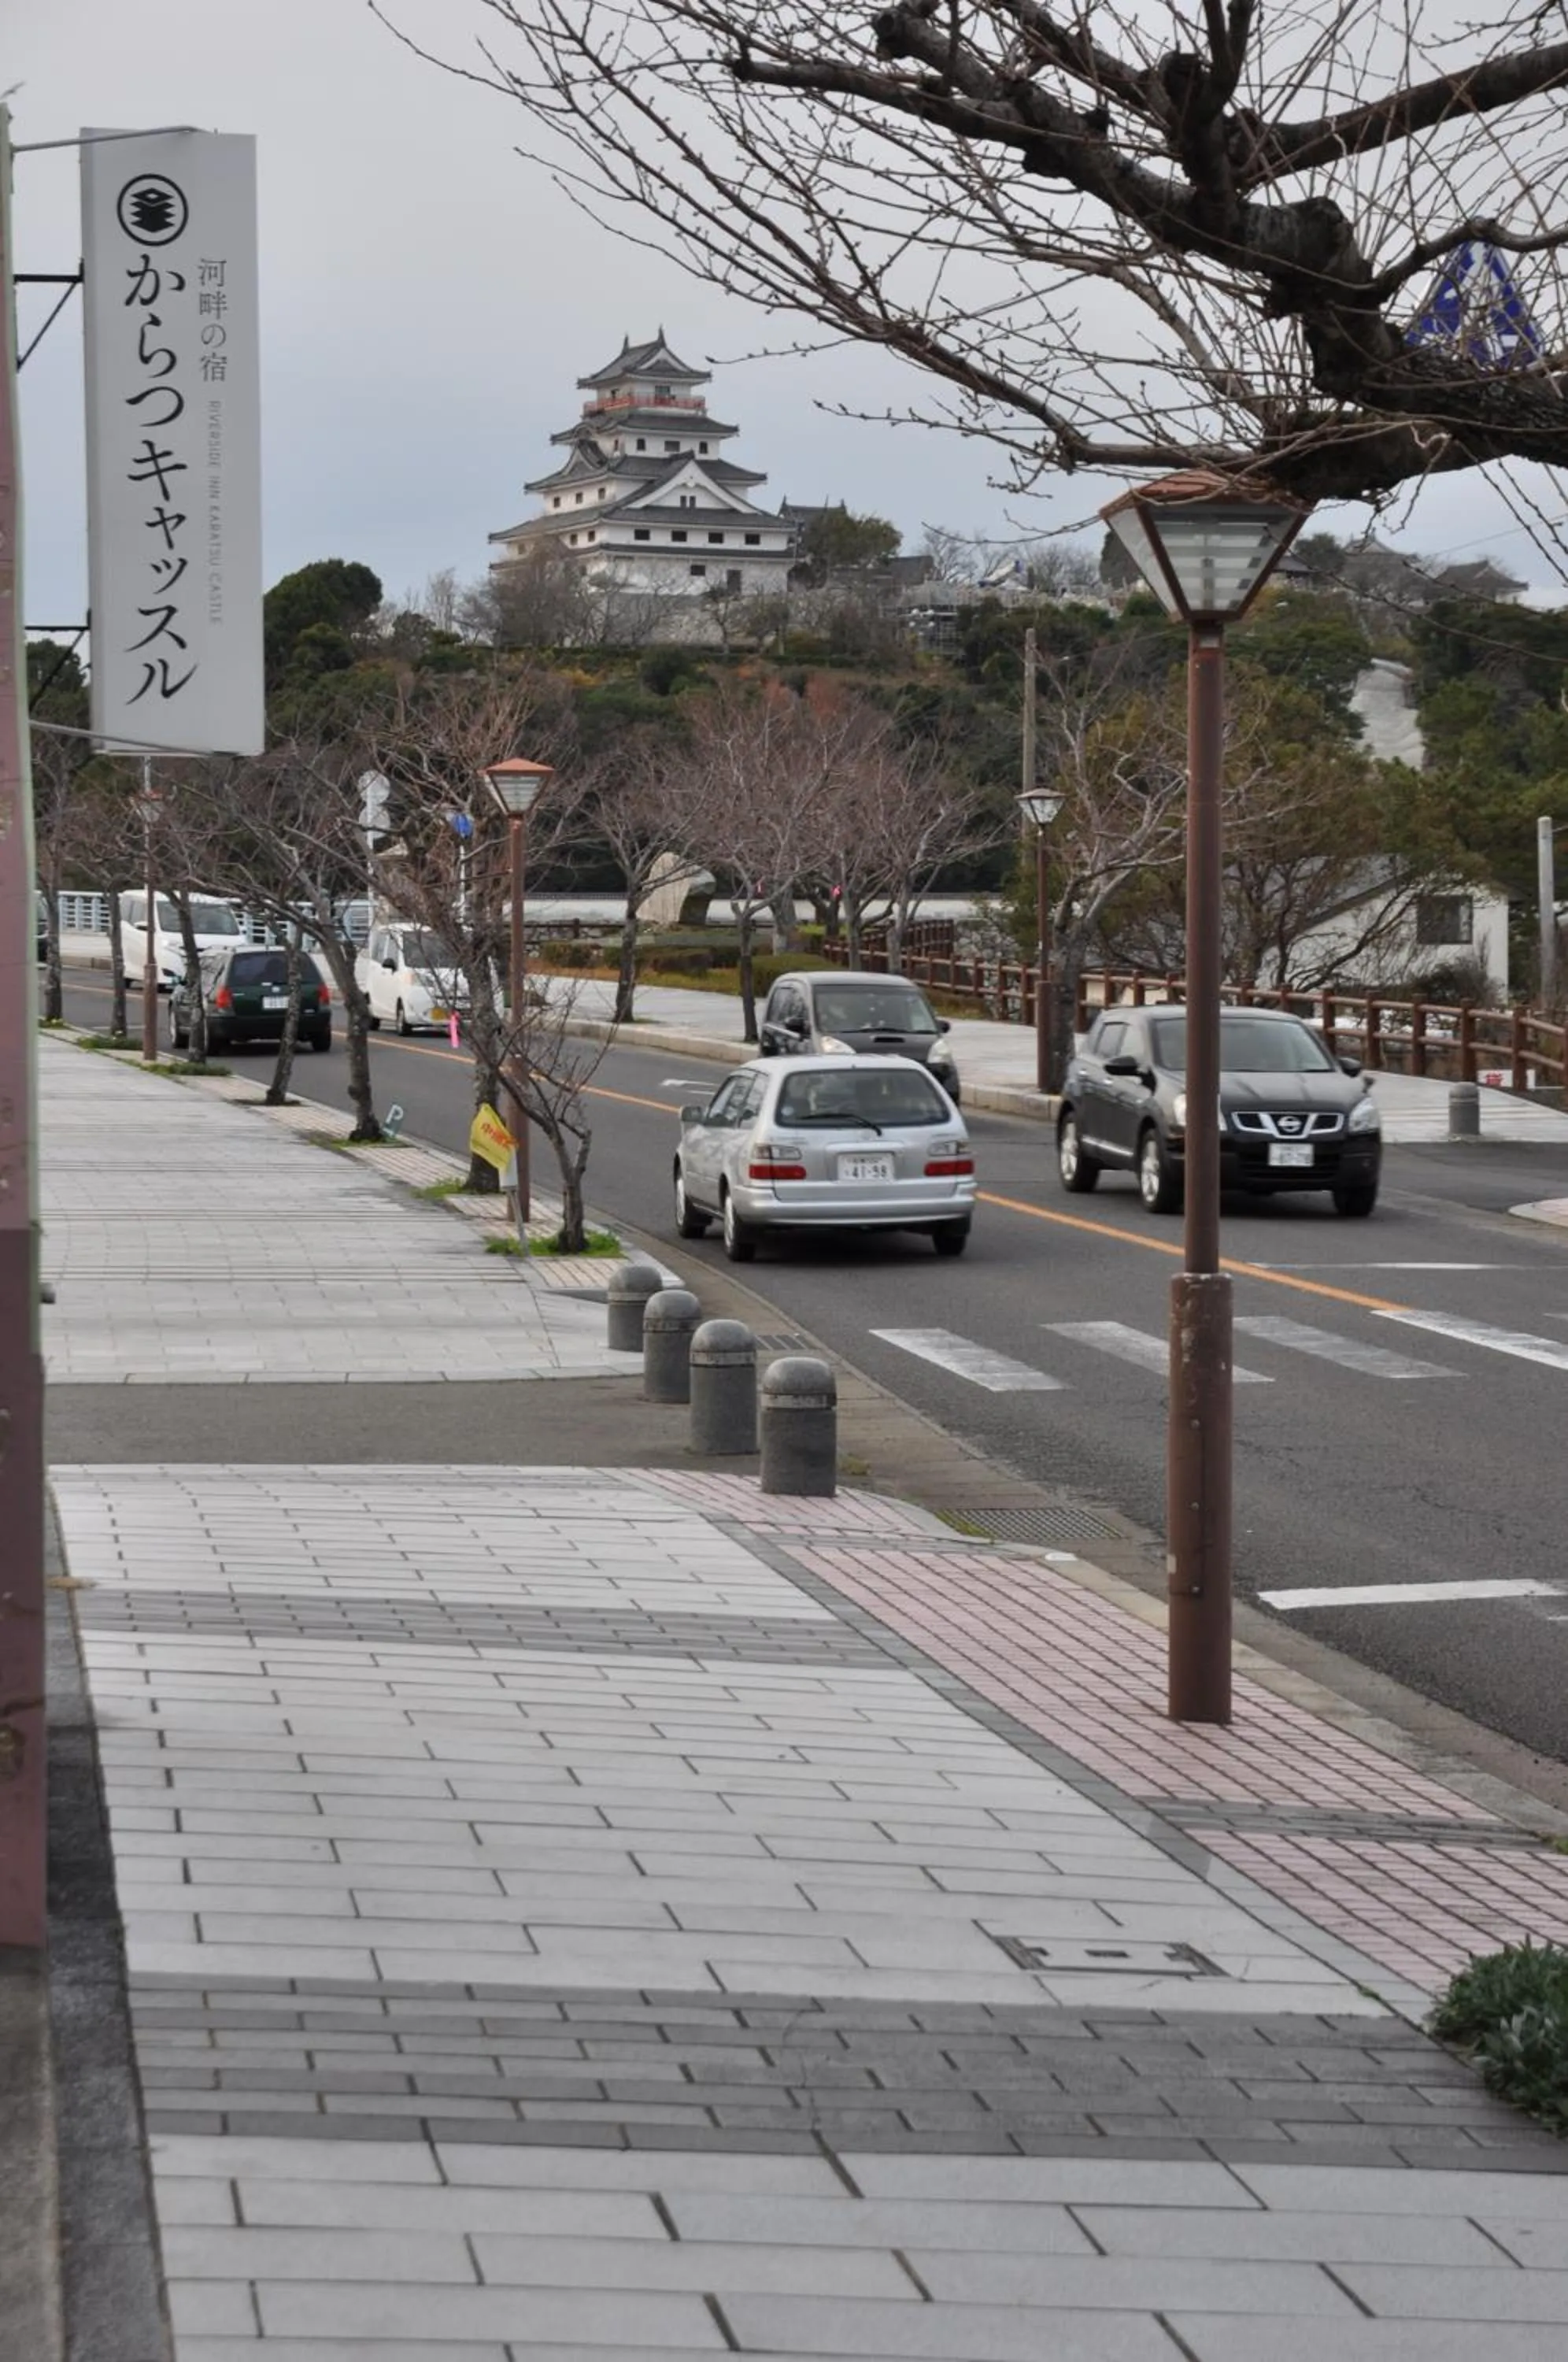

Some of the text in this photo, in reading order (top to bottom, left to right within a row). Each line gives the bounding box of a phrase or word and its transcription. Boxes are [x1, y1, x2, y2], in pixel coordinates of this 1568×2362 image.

[198, 258, 227, 382] 河畔の宿
[124, 254, 201, 705] からつキャッスル
[208, 400, 222, 624] RIVERSIDE INN KARATSU CASTLE
